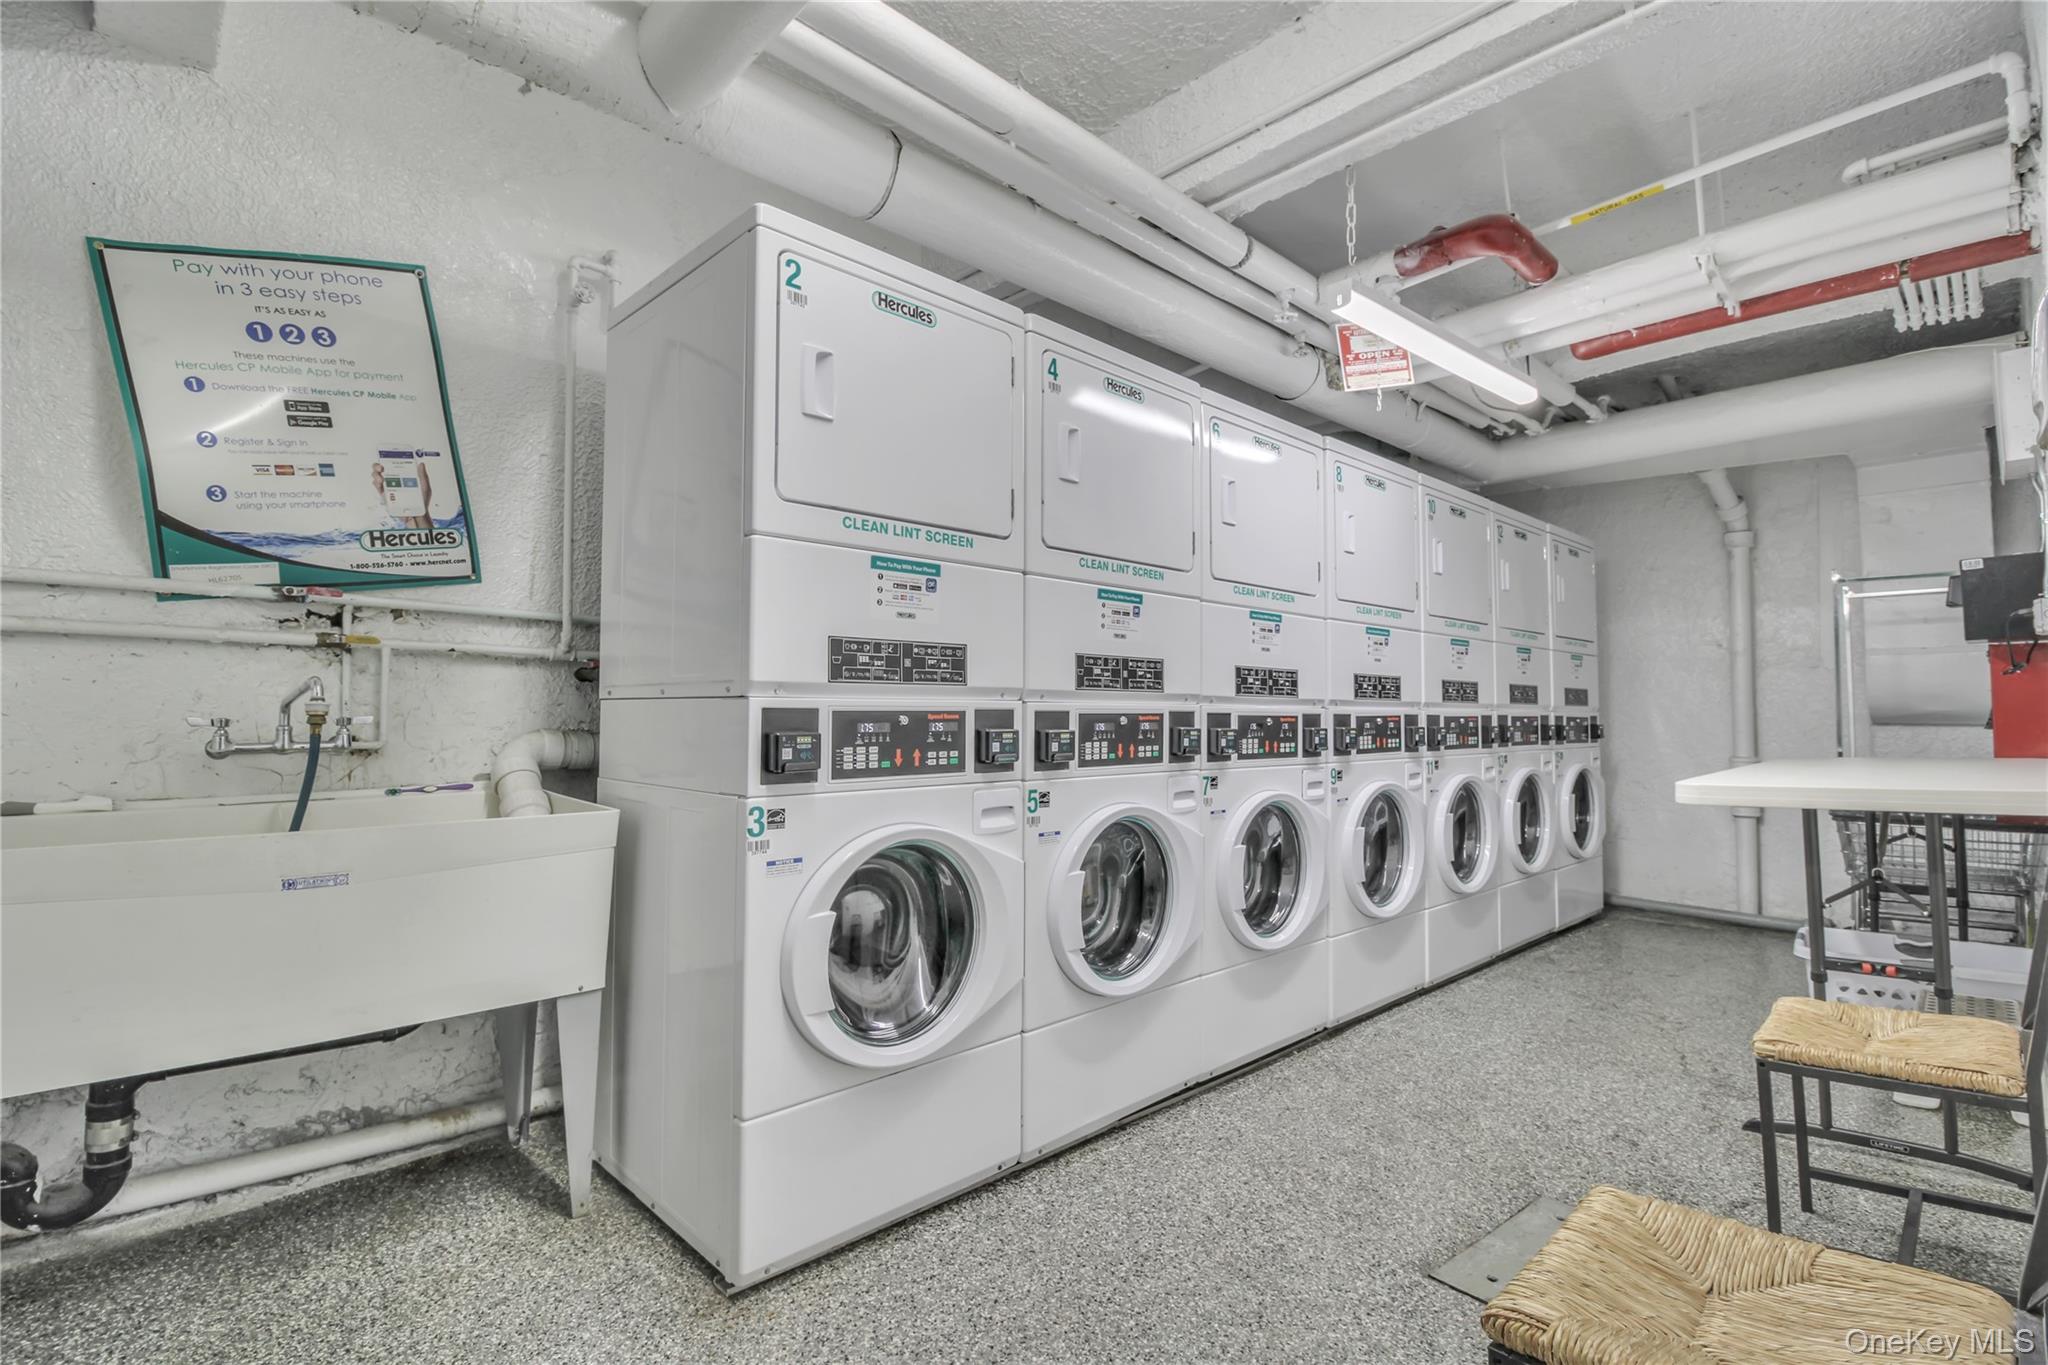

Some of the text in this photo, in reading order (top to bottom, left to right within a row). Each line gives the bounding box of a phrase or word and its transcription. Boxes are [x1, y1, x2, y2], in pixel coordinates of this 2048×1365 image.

[1589, 193, 1644, 217] NATURAL GAS
[172, 258, 383, 288] Pay with your phone
[785, 259, 802, 290] 2
[215, 281, 362, 306] in 3 easy steps
[254, 305, 326, 318] IT'S AS EASY AS
[878, 292, 933, 324] Hercules
[233, 350, 356, 367] These machines use the
[1359, 351, 1390, 360] OPEN
[175, 360, 404, 383] Hercules CP Mobile App for payment
[1047, 358, 1059, 381] 4
[212, 382, 266, 393] Download
[268, 383, 285, 394] the
[287, 385, 310, 395] FREE
[311, 387, 351, 397] Hercules
[352, 389, 365, 398] CP
[367, 390, 397, 400] Mobile
[399, 392, 417, 402] App
[1107, 378, 1142, 401] Hercules
[223, 436, 263, 447] Register
[267, 438, 274, 446] &
[276, 439, 297, 448] Sign
[1336, 466, 1342, 482] 8
[234, 491, 257, 499] Start
[259, 490, 277, 499] the
[279, 490, 322, 499] machine
[236, 500, 347, 511] using your smartphone
[369, 529, 457, 547] Hercules
[842, 516, 974, 549] CLEAN LINT SCREEN
[410, 558, 467, 566] www.hercnet.com
[1079, 557, 1165, 581] CLEAN LINT SCREEN
[1233, 585, 1295, 603] CLEAN LINT SCREEN
[1202, 776, 1210, 796] 7
[1331, 768, 1337, 785] 9
[1028, 789, 1038, 813] 5
[747, 806, 765, 837] 3
